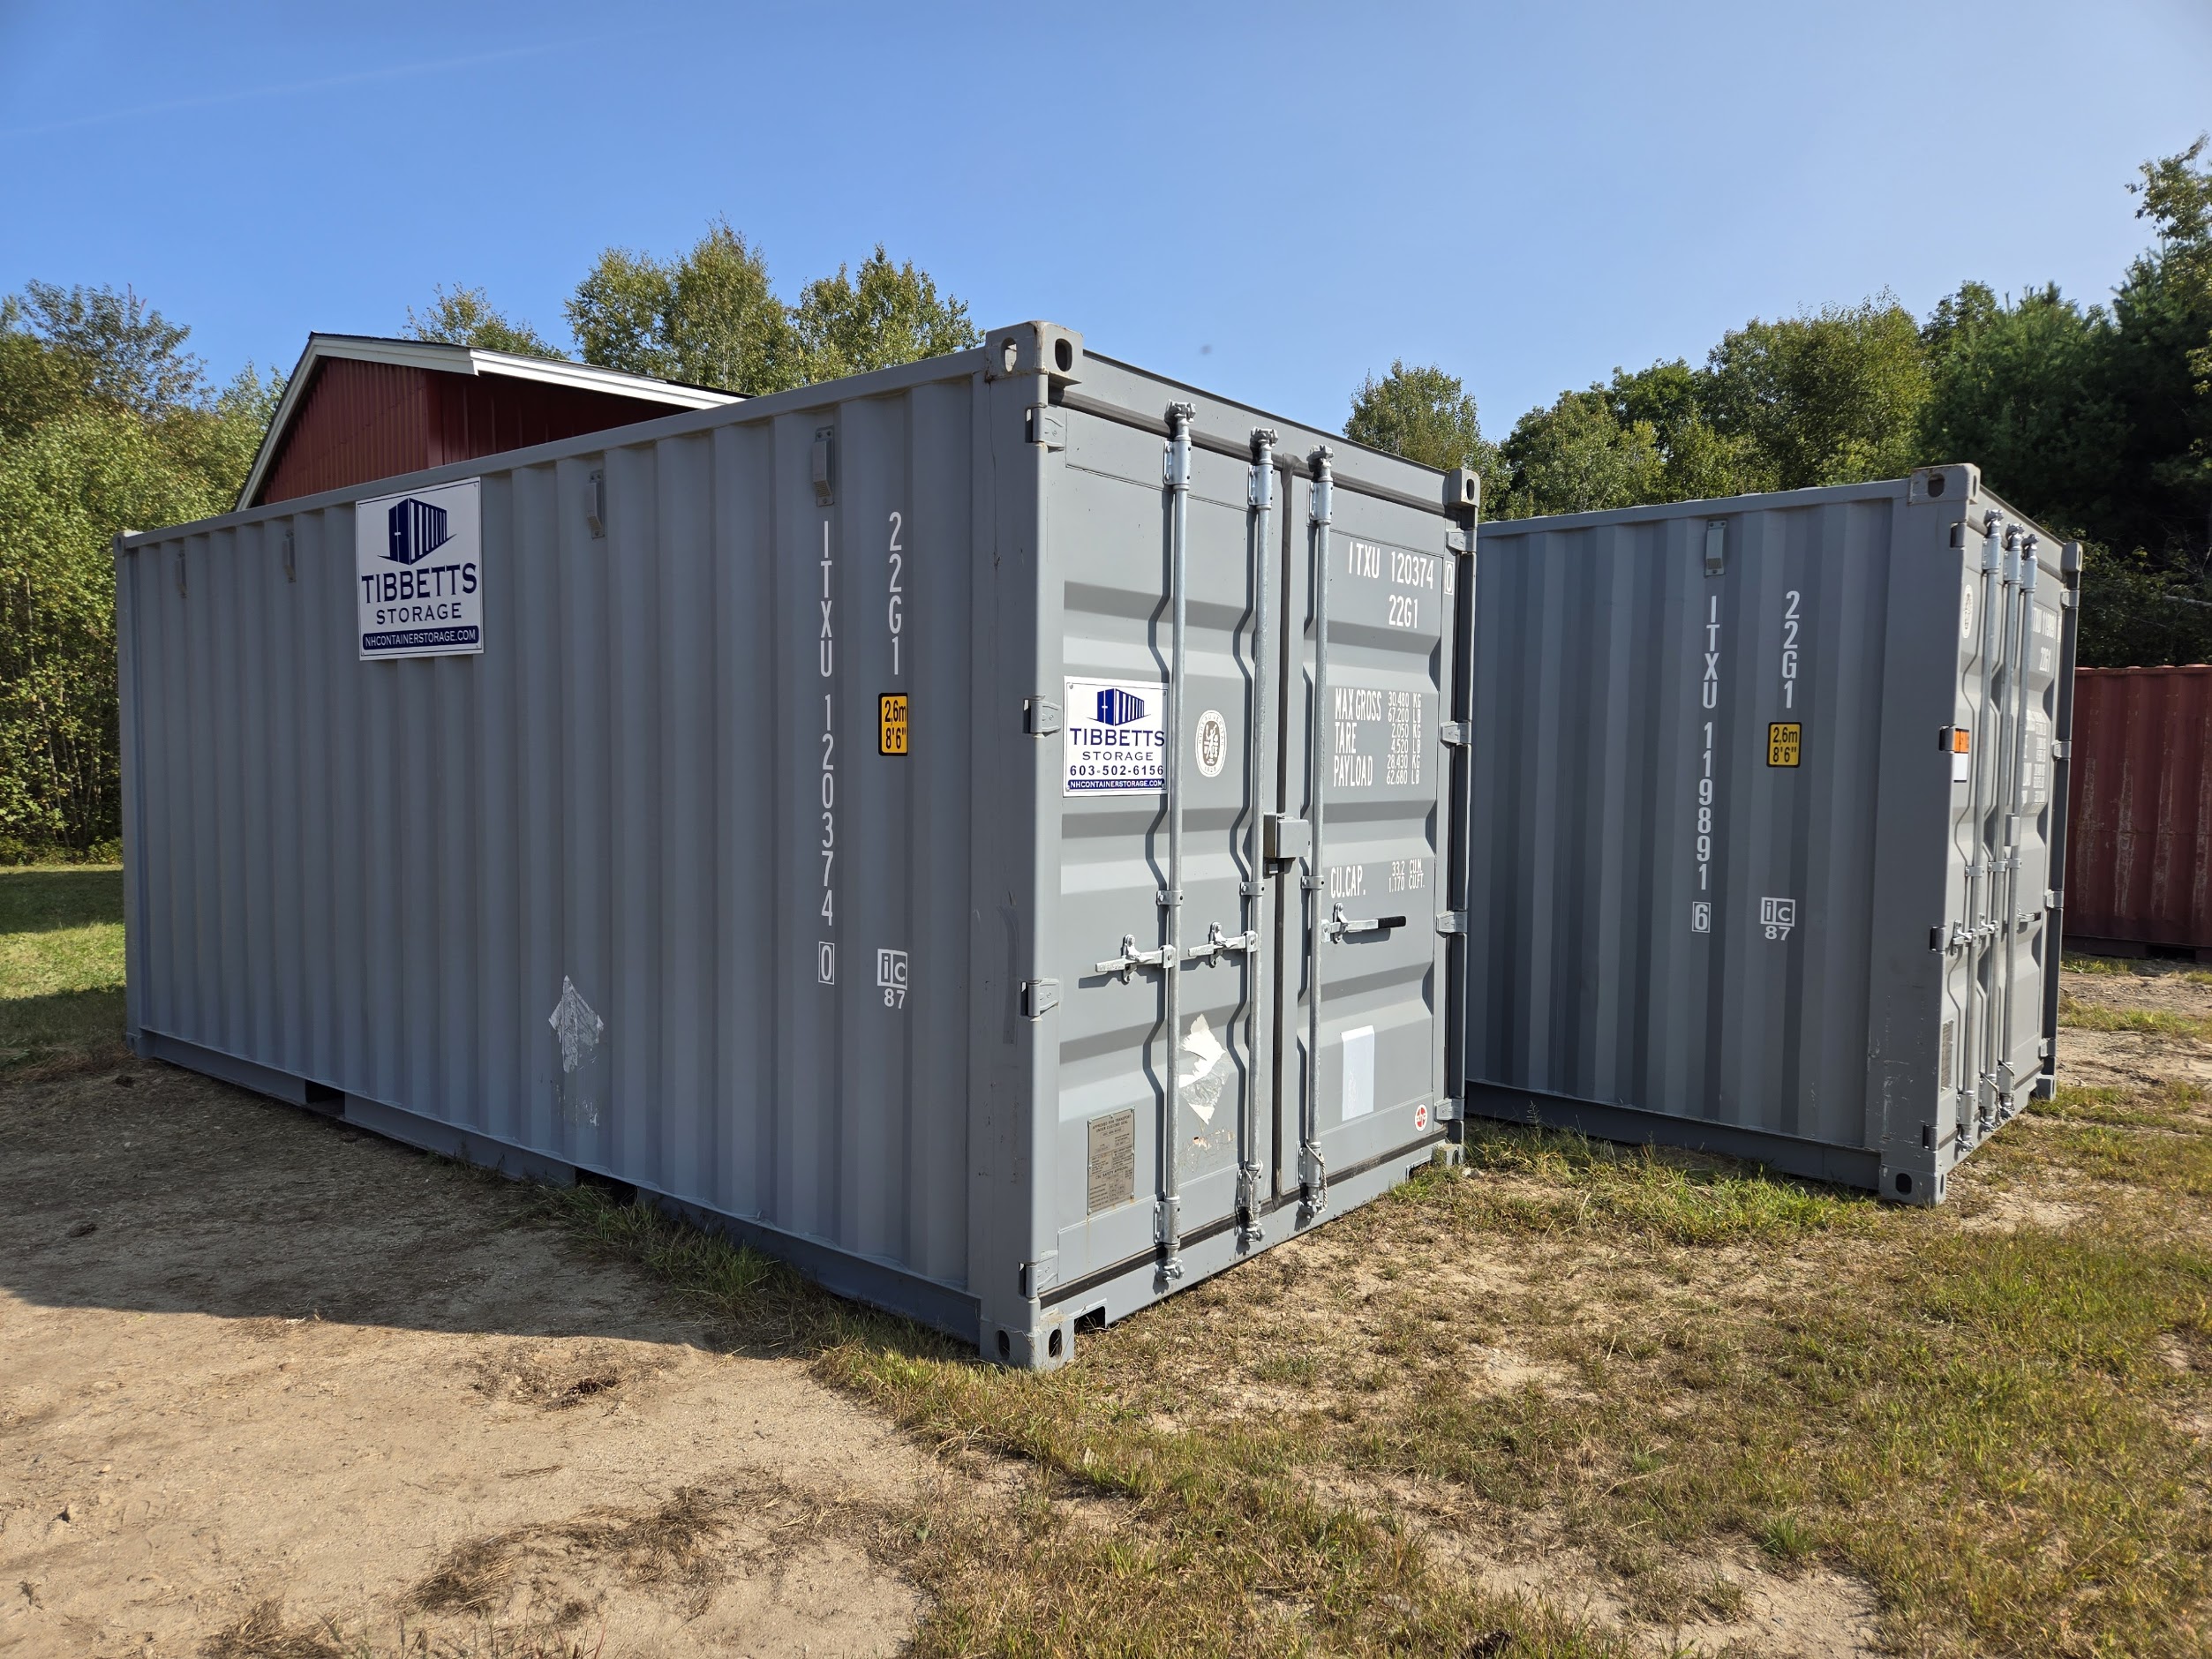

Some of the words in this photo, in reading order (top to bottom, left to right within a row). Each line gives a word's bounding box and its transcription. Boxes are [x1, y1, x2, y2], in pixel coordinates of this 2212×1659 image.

[1349, 541, 1381, 579] ITXU
[1391, 551, 1434, 589] 120374
[361, 562, 478, 604] TIBBETTS
[889, 511, 902, 675] 22G1
[820, 521, 832, 677] ITXU
[376, 602, 462, 625] STORAGE
[1388, 594, 1418, 628] 22G1
[365, 629, 476, 648] NHCONTAINERSTORAGE.COM
[1781, 590, 1800, 709] 22G1
[1703, 595, 1720, 709] ITXU
[1335, 687, 1355, 721] MAX
[1356, 689, 1381, 722] GROSS
[1388, 691, 1409, 708] 30.480
[1413, 693, 1421, 709] KG
[884, 700, 906, 725] 2,6m
[1412, 709, 1421, 723] LB
[885, 727, 906, 749] 8'6"
[1070, 728, 1165, 747] TIBBETTS
[1335, 722, 1357, 754] TARE
[1391, 724, 1409, 739] 2.050
[1412, 724, 1421, 739] KG
[1772, 726, 1797, 746] 2,6m
[1082, 751, 1154, 761] STORAGE
[1391, 739, 1409, 754] 4.520
[1412, 739, 1421, 754] LB
[1772, 746, 1796, 762] 8'6"
[1070, 765, 1164, 776] 603-502-6156
[1334, 755, 1373, 787] PAYLOAD
[1387, 754, 1408, 769] 28.430
[1411, 754, 1420, 769] KG
[1386, 769, 1408, 785] 62.680
[1411, 769, 1420, 784] LB
[821, 694, 834, 926] 120374
[1697, 722, 1712, 890] 119891
[1391, 860, 1405, 877] 33.2
[1330, 865, 1366, 899] CU.CAP.
[1388, 875, 1405, 893] 1.170
[1764, 926, 1791, 941] 87
[884, 987, 906, 1009] 87
